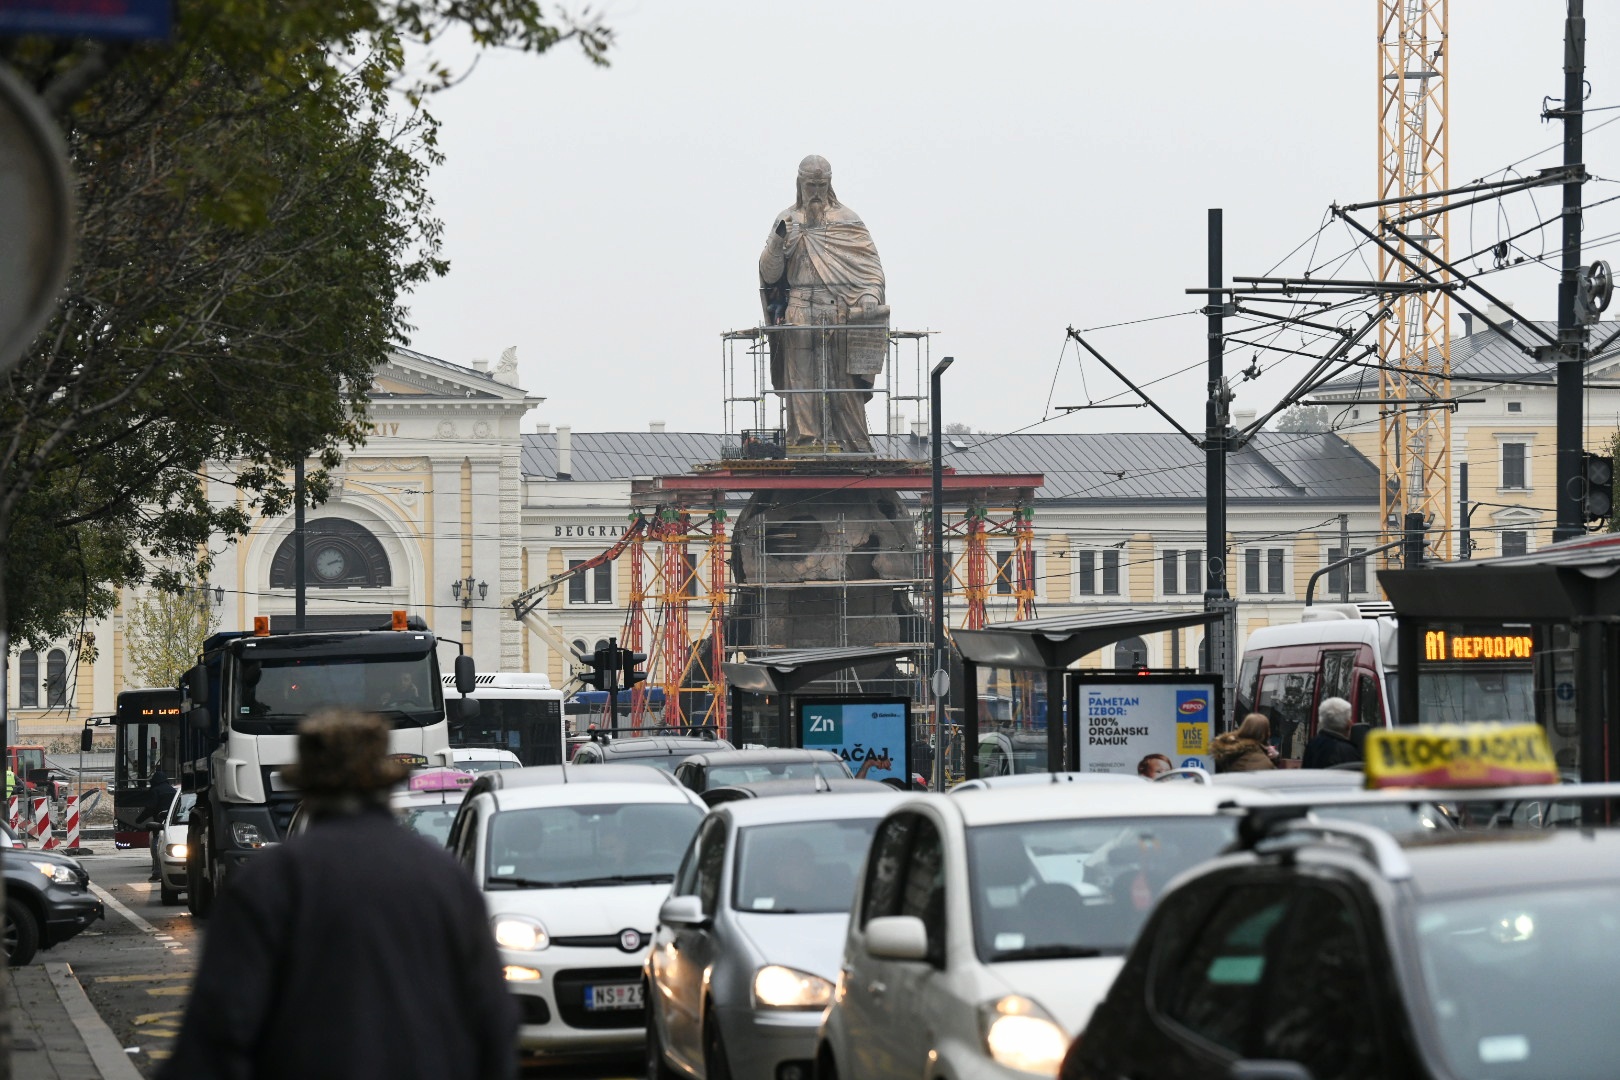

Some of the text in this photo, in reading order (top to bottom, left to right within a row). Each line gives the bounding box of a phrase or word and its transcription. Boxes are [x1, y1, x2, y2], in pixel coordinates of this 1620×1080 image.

[554, 526, 628, 537] BEOGRAD
[1088, 697, 1139, 706] PAMETAN
[1088, 707, 1127, 716] IZBOR:
[809, 715, 835, 732] Zn
[1088, 717, 1119, 727] 100%
[1088, 726, 1149, 736] ORGANSKI
[1182, 727, 1203, 740] VIŠE
[1088, 736, 1128, 746] PAMUK
[596, 986, 615, 1003] NS
